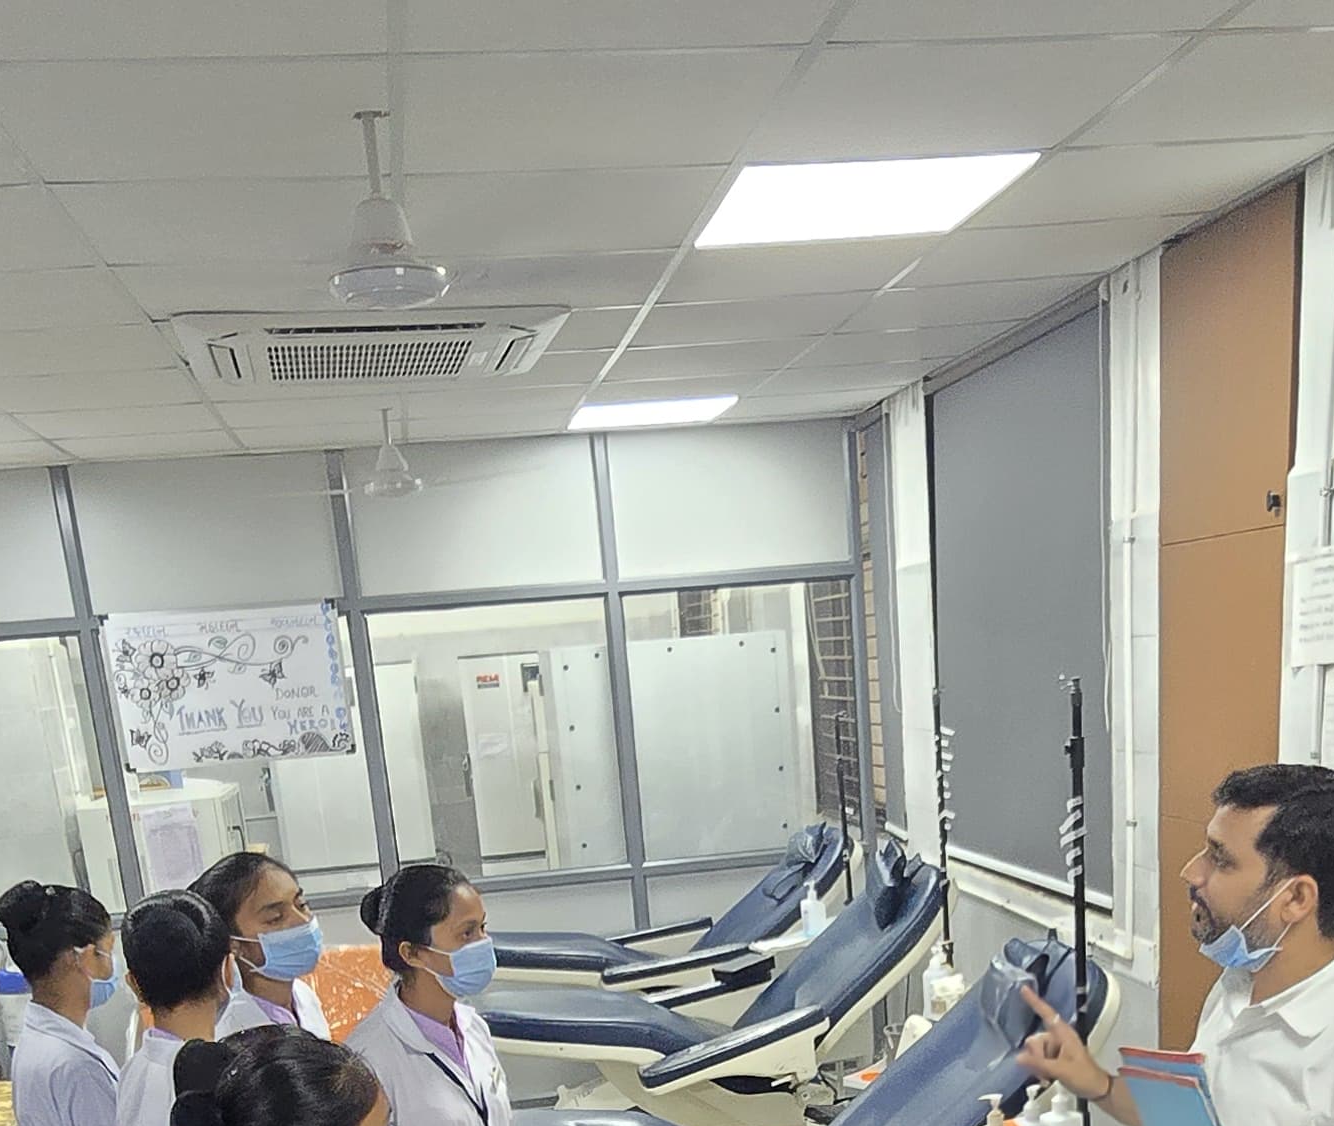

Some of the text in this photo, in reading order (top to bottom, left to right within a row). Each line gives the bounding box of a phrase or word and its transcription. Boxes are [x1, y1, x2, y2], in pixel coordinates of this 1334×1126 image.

[275, 685, 319, 701] DONOR
[176, 699, 264, 731] THANK YOU
[271, 704, 330, 721] YOU ARE A
